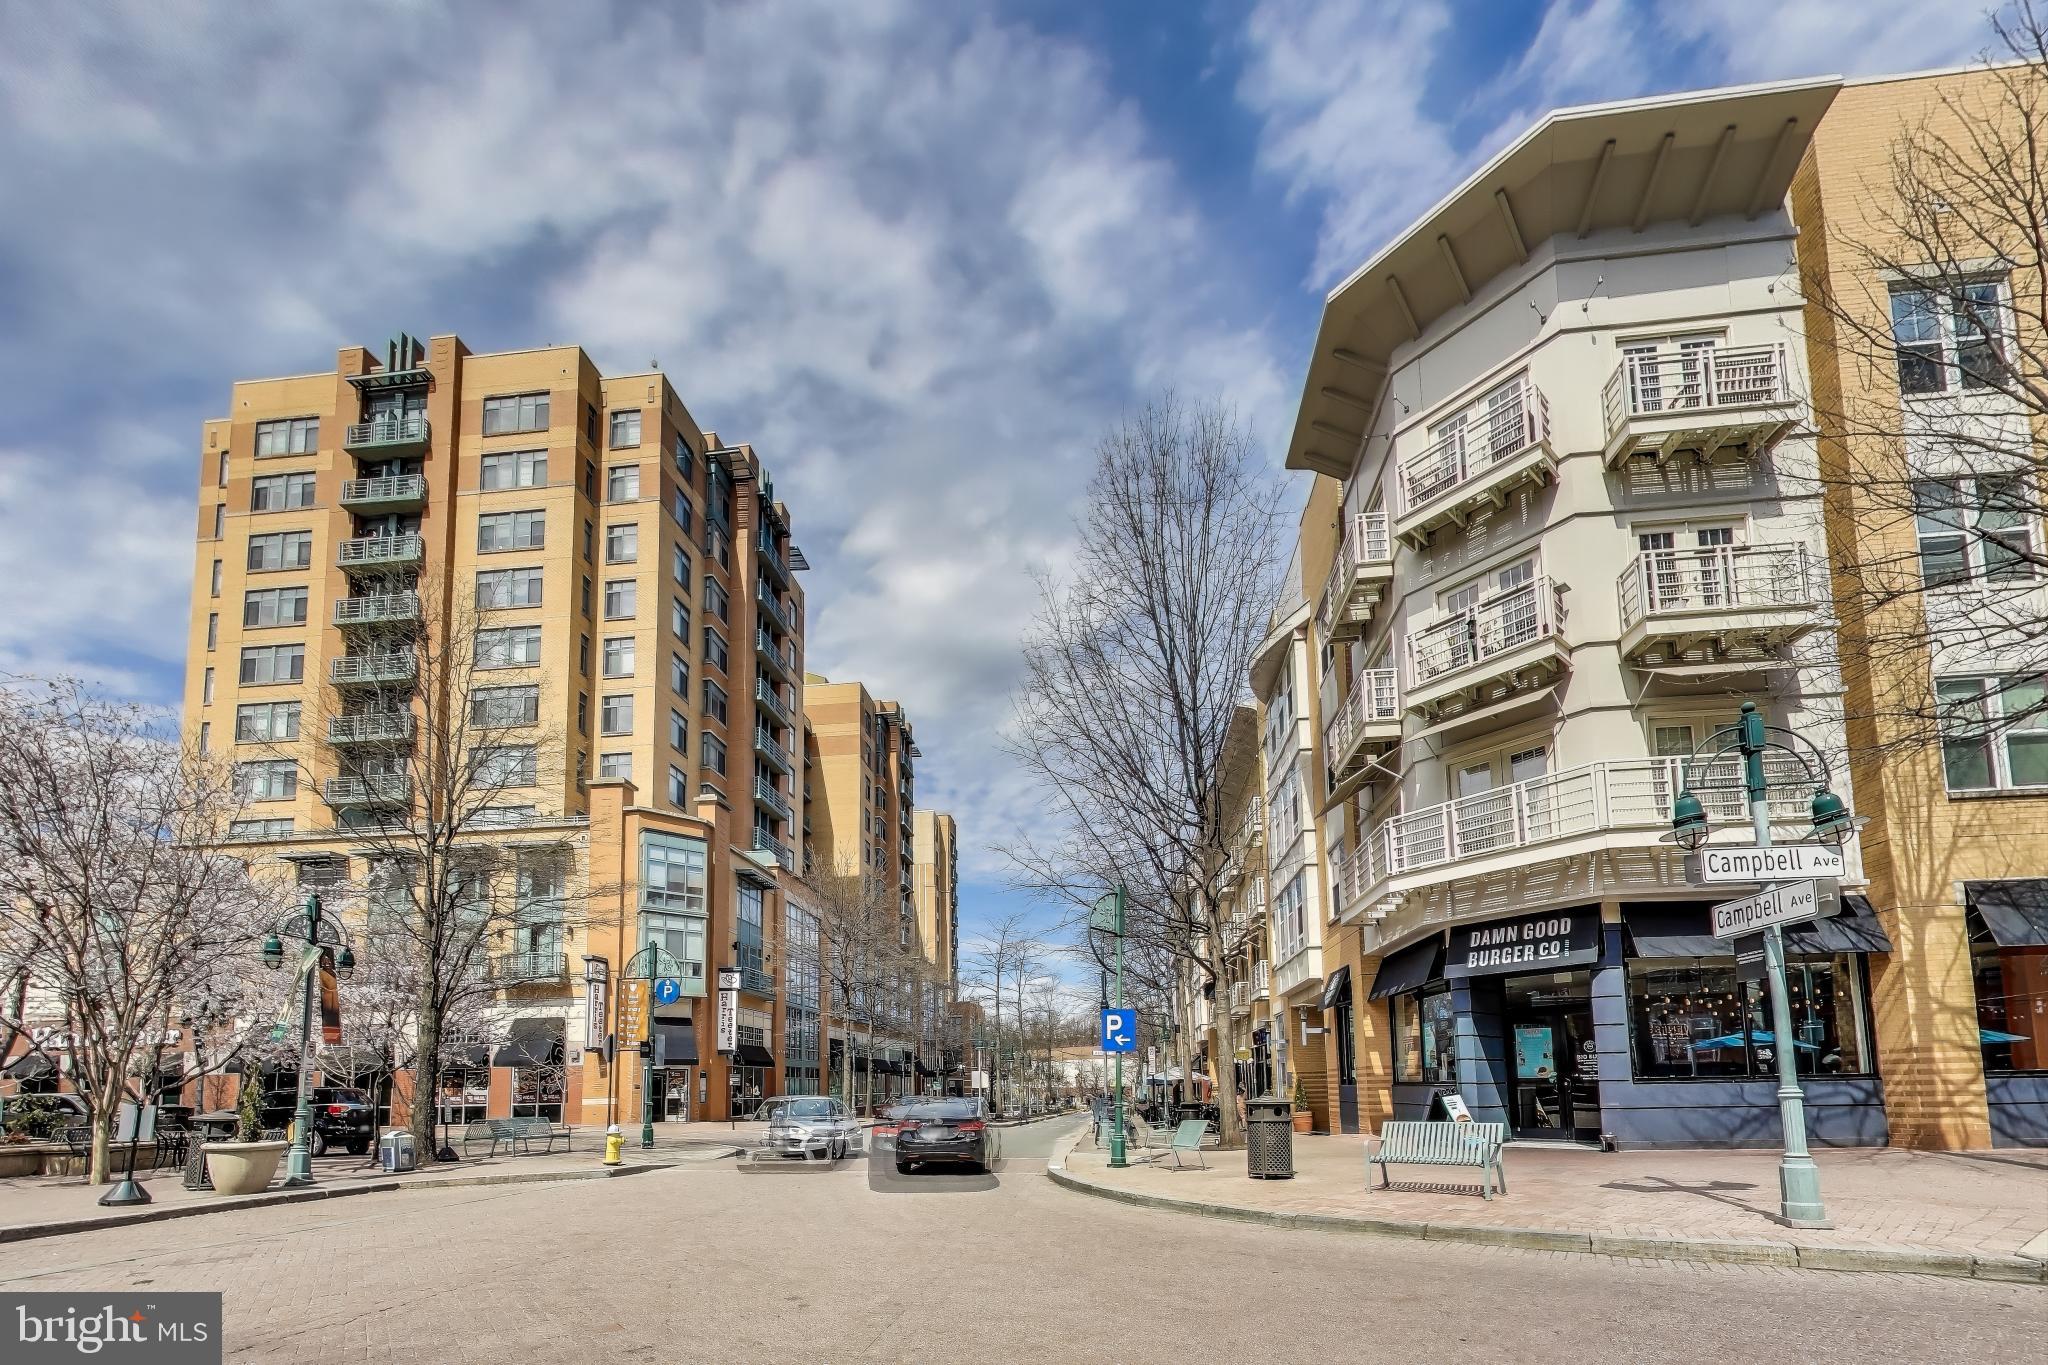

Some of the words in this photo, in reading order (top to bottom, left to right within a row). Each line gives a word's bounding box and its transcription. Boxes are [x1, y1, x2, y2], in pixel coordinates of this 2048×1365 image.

[1708, 849, 1803, 878] Campbell
[1813, 856, 1840, 867] Ave
[1717, 892, 1783, 929] Campbell
[1790, 893, 1813, 908] Ave
[1470, 925, 1518, 948] DAMN
[1523, 917, 1572, 940] GOOD
[1467, 944, 1535, 968] BURGER
[1539, 940, 1561, 956] CO
[664, 985, 673, 998] P
[720, 993, 728, 1034] Harris
[1106, 1014, 1122, 1040] P
